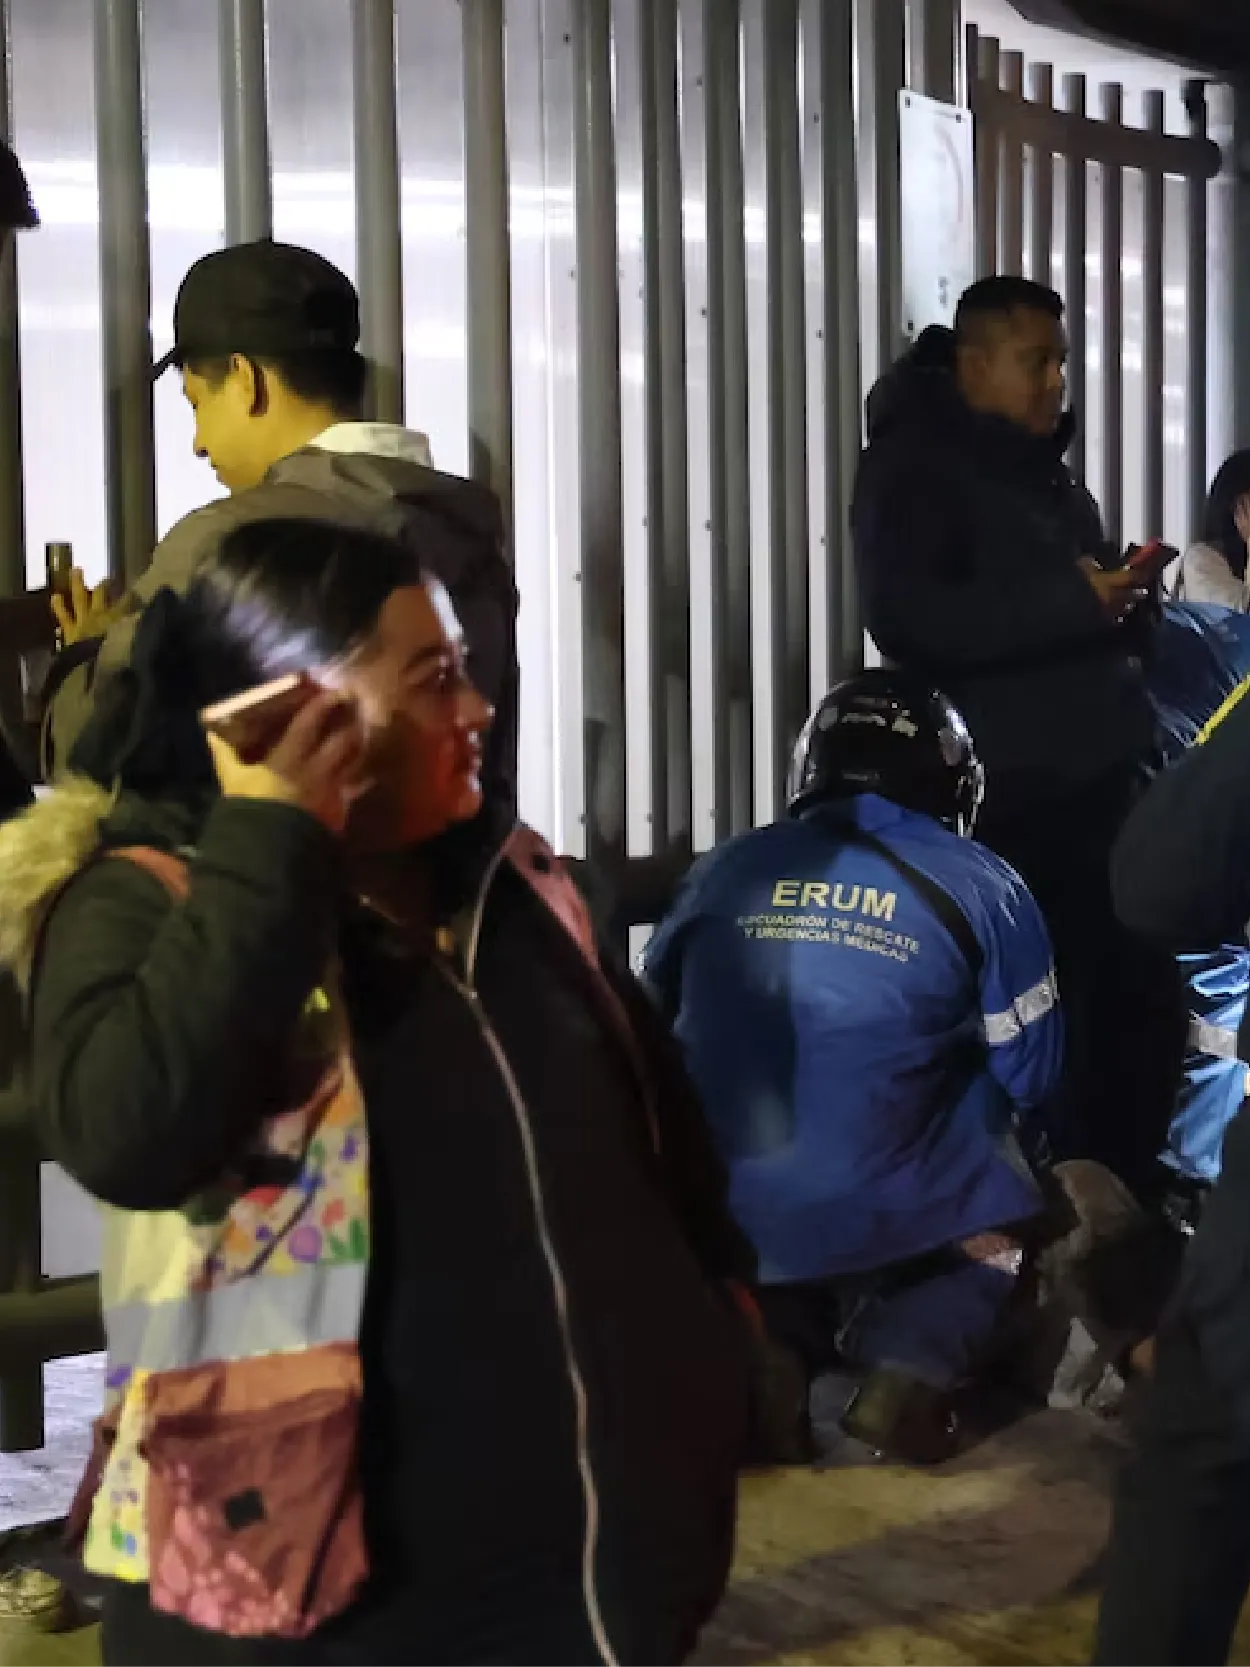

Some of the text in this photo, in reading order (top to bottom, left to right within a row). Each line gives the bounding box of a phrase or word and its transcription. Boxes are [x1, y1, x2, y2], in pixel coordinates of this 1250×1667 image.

[772, 879, 897, 922] ERUM
[831, 917, 852, 932] DE
[744, 927, 754, 939] Y
[756, 927, 840, 944] URGENCIAS
